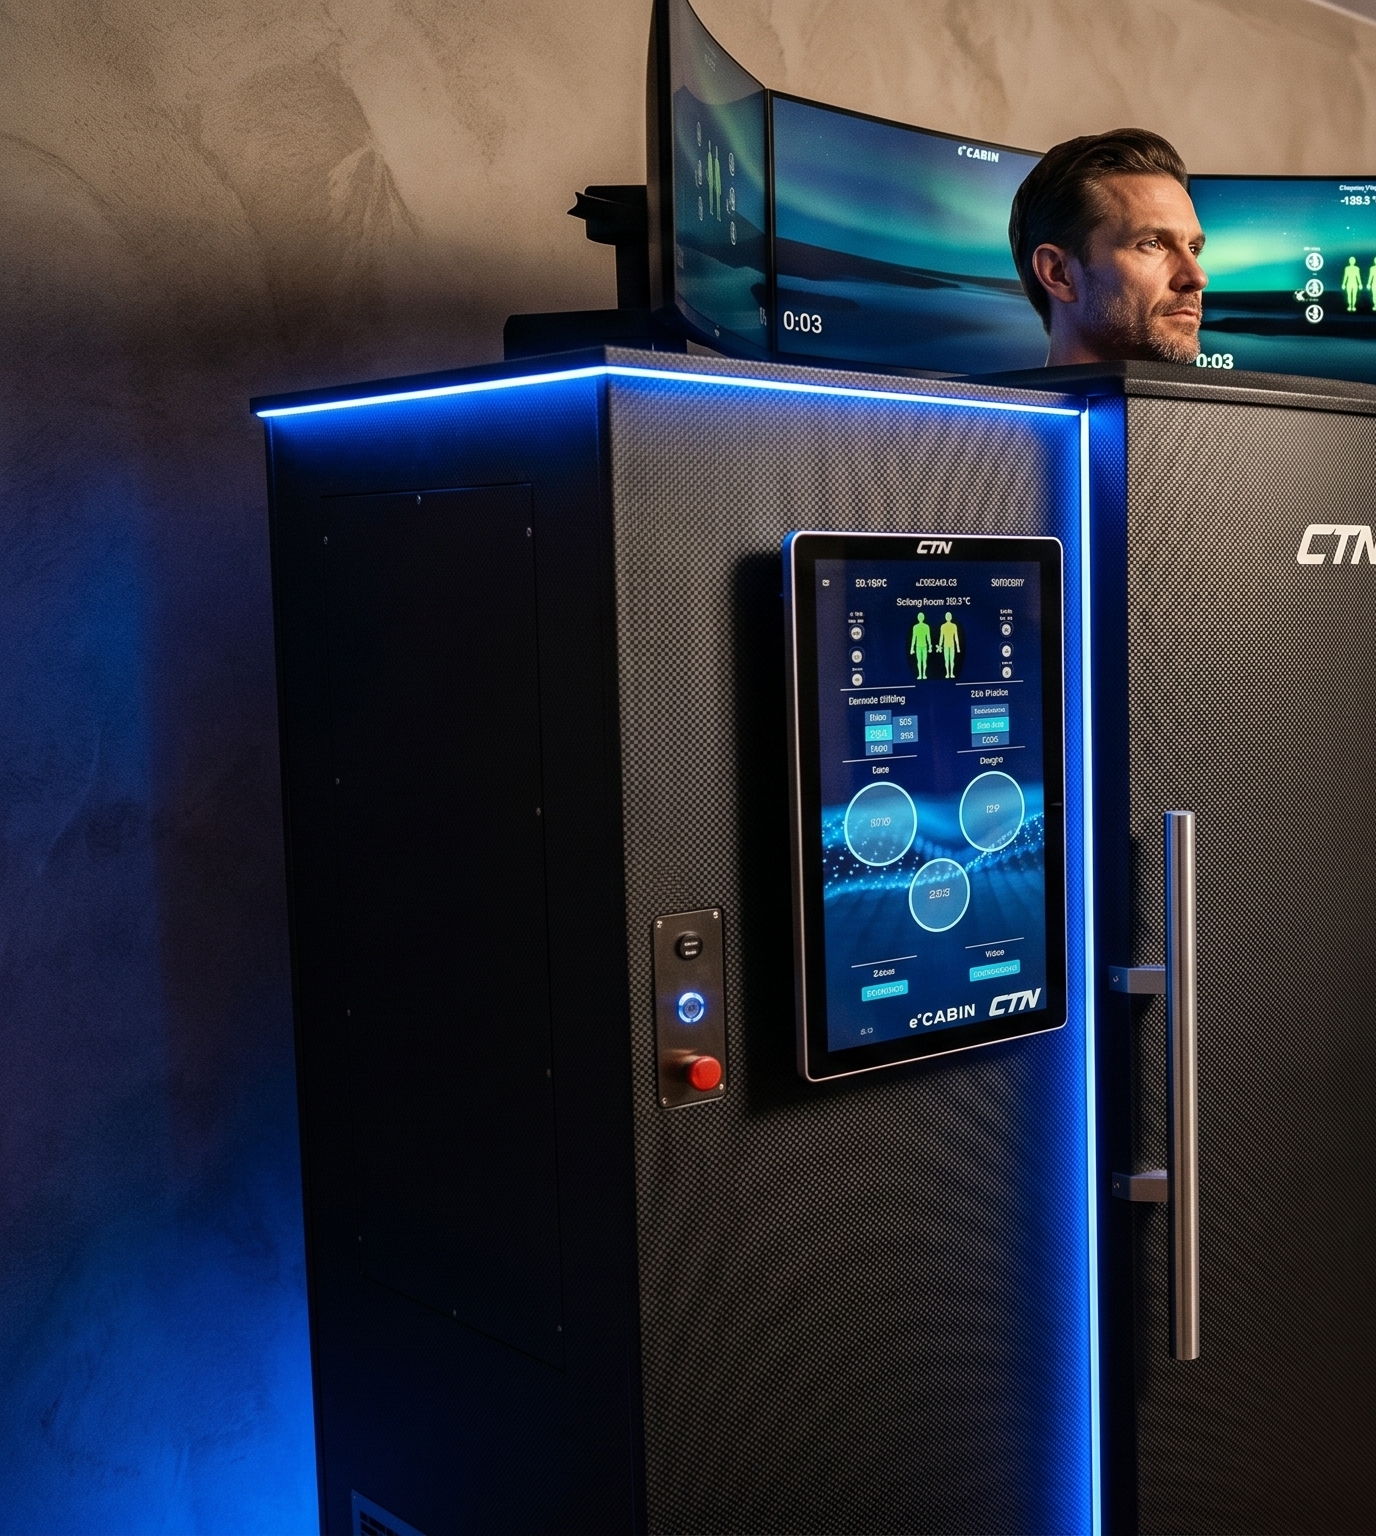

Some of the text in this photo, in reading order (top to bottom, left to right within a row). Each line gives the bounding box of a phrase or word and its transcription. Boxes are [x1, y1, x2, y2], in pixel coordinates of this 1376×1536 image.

[783, 310, 823, 334] 0:03
[1196, 353, 1234, 370] 0:03
[916, 540, 953, 554] CTN
[988, 987, 1042, 1017] CTN
